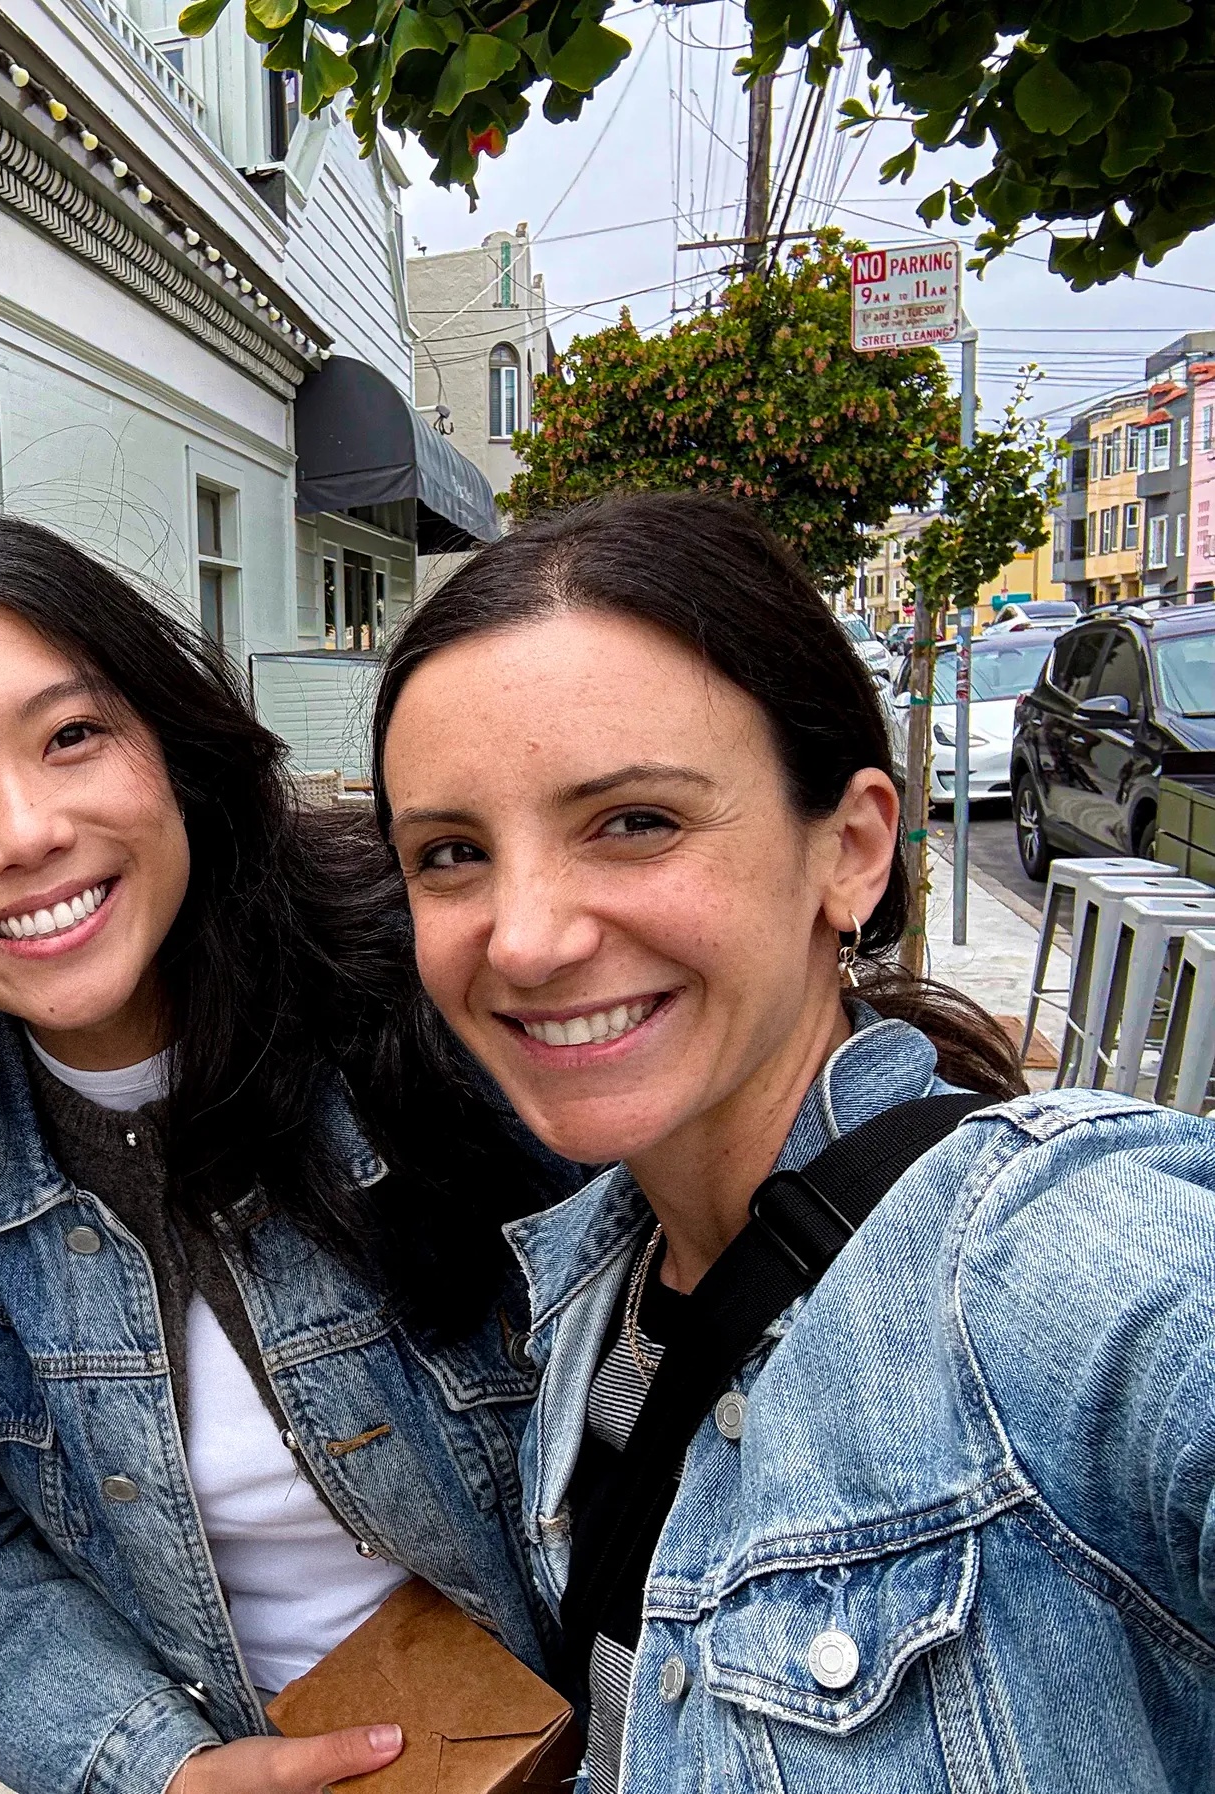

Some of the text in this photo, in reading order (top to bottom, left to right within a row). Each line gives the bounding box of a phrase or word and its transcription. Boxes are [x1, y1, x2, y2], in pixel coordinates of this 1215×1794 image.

[856, 251, 953, 281] NO PARKING
[874, 311, 890, 322] and
[907, 304, 946, 316] TUESDAY
[861, 327, 950, 347] STREET CLEANING
